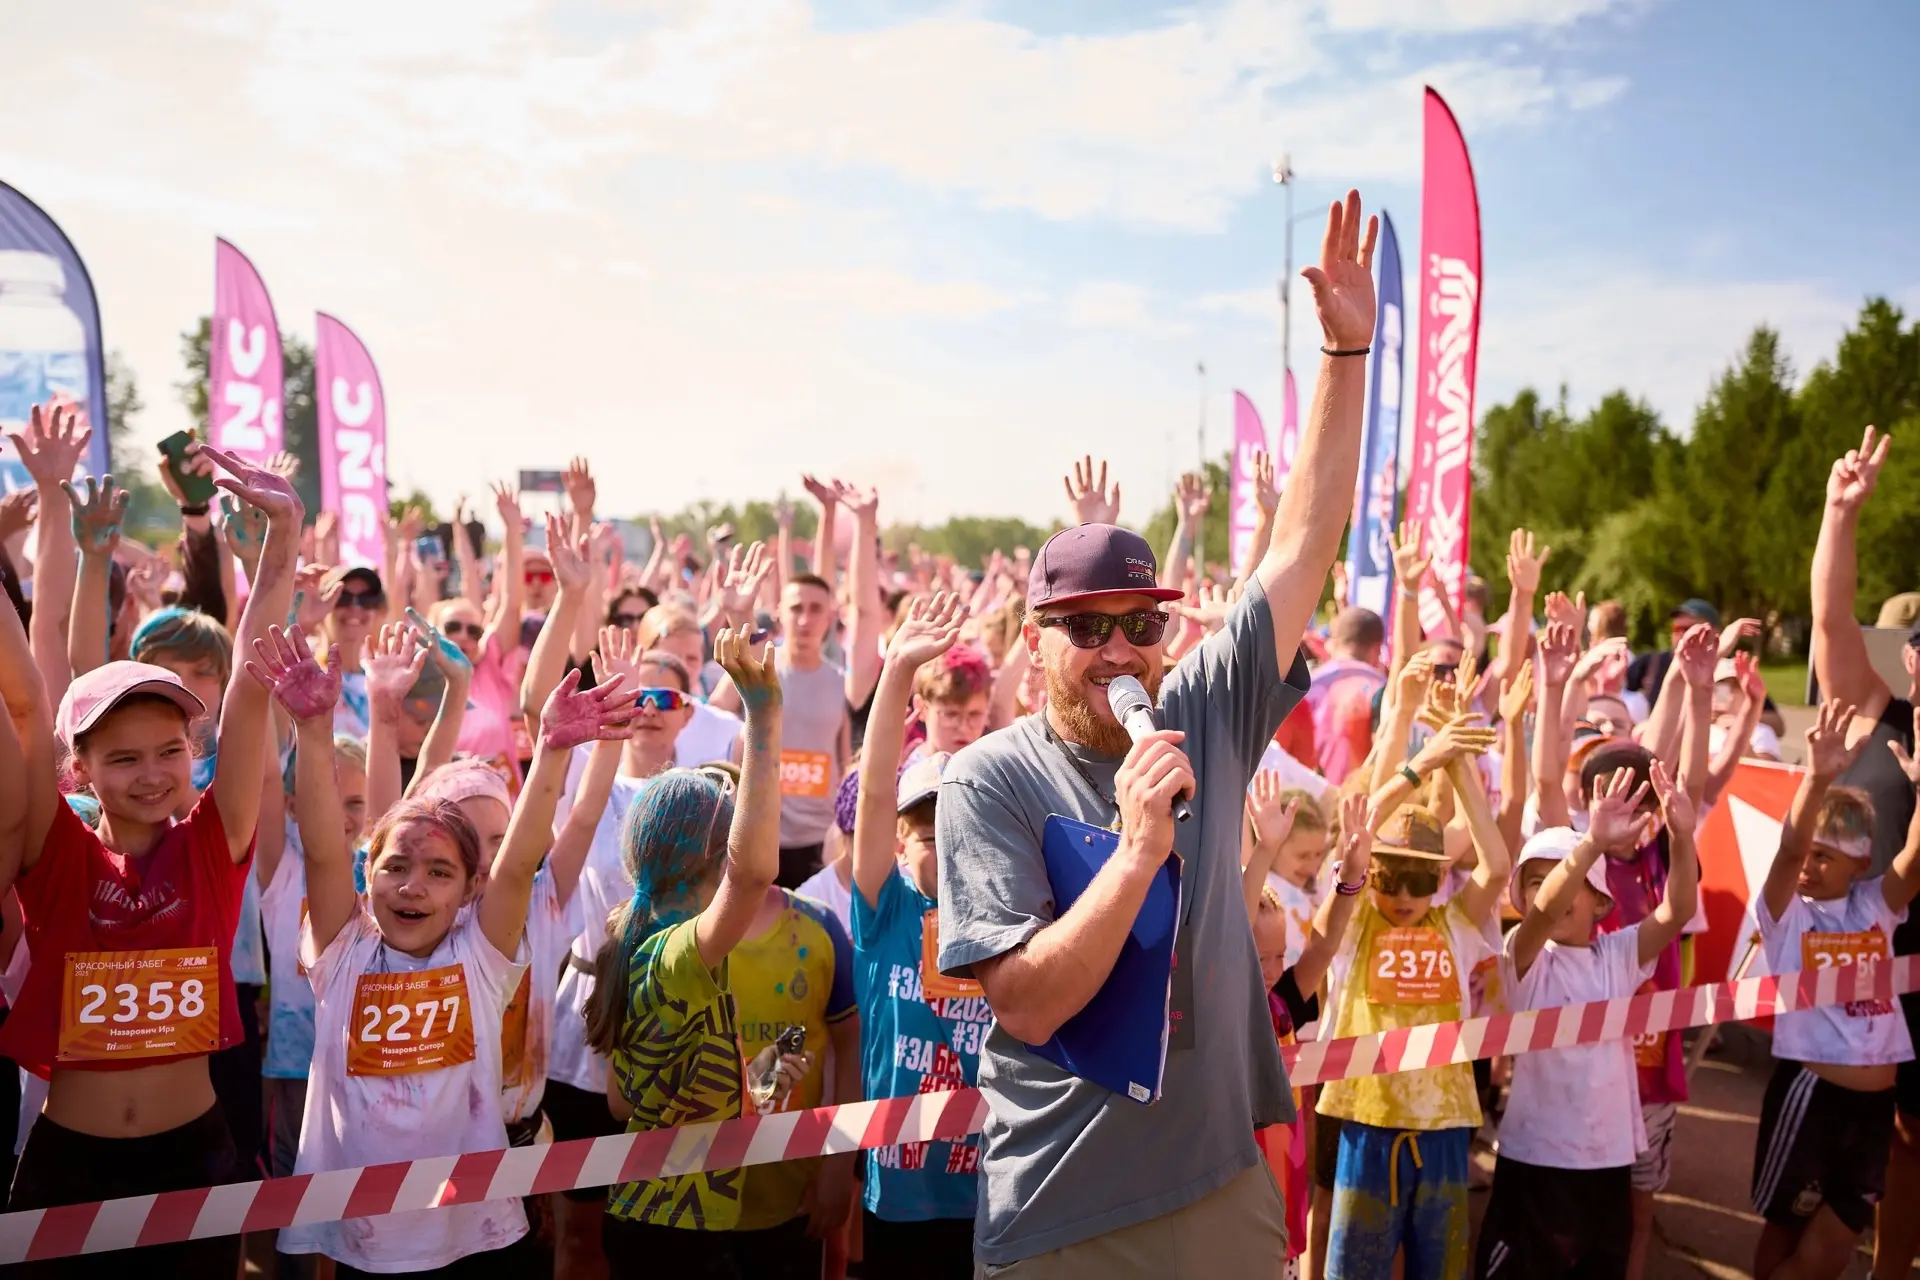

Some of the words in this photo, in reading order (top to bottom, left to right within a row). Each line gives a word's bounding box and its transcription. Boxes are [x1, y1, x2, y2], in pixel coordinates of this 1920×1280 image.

[75, 959, 135, 970] КРАСОЧНЫЙ
[136, 959, 166, 969] ЗАБЕГ
[1377, 949, 1452, 979] 2376
[404, 980, 431, 991] ЗАБЕГ
[79, 978, 206, 1024] 2358
[361, 995, 460, 1042] 2277
[110, 1028, 157, 1037] Назарович
[158, 1025, 175, 1035] Ира
[381, 1046, 418, 1055] Назарова
